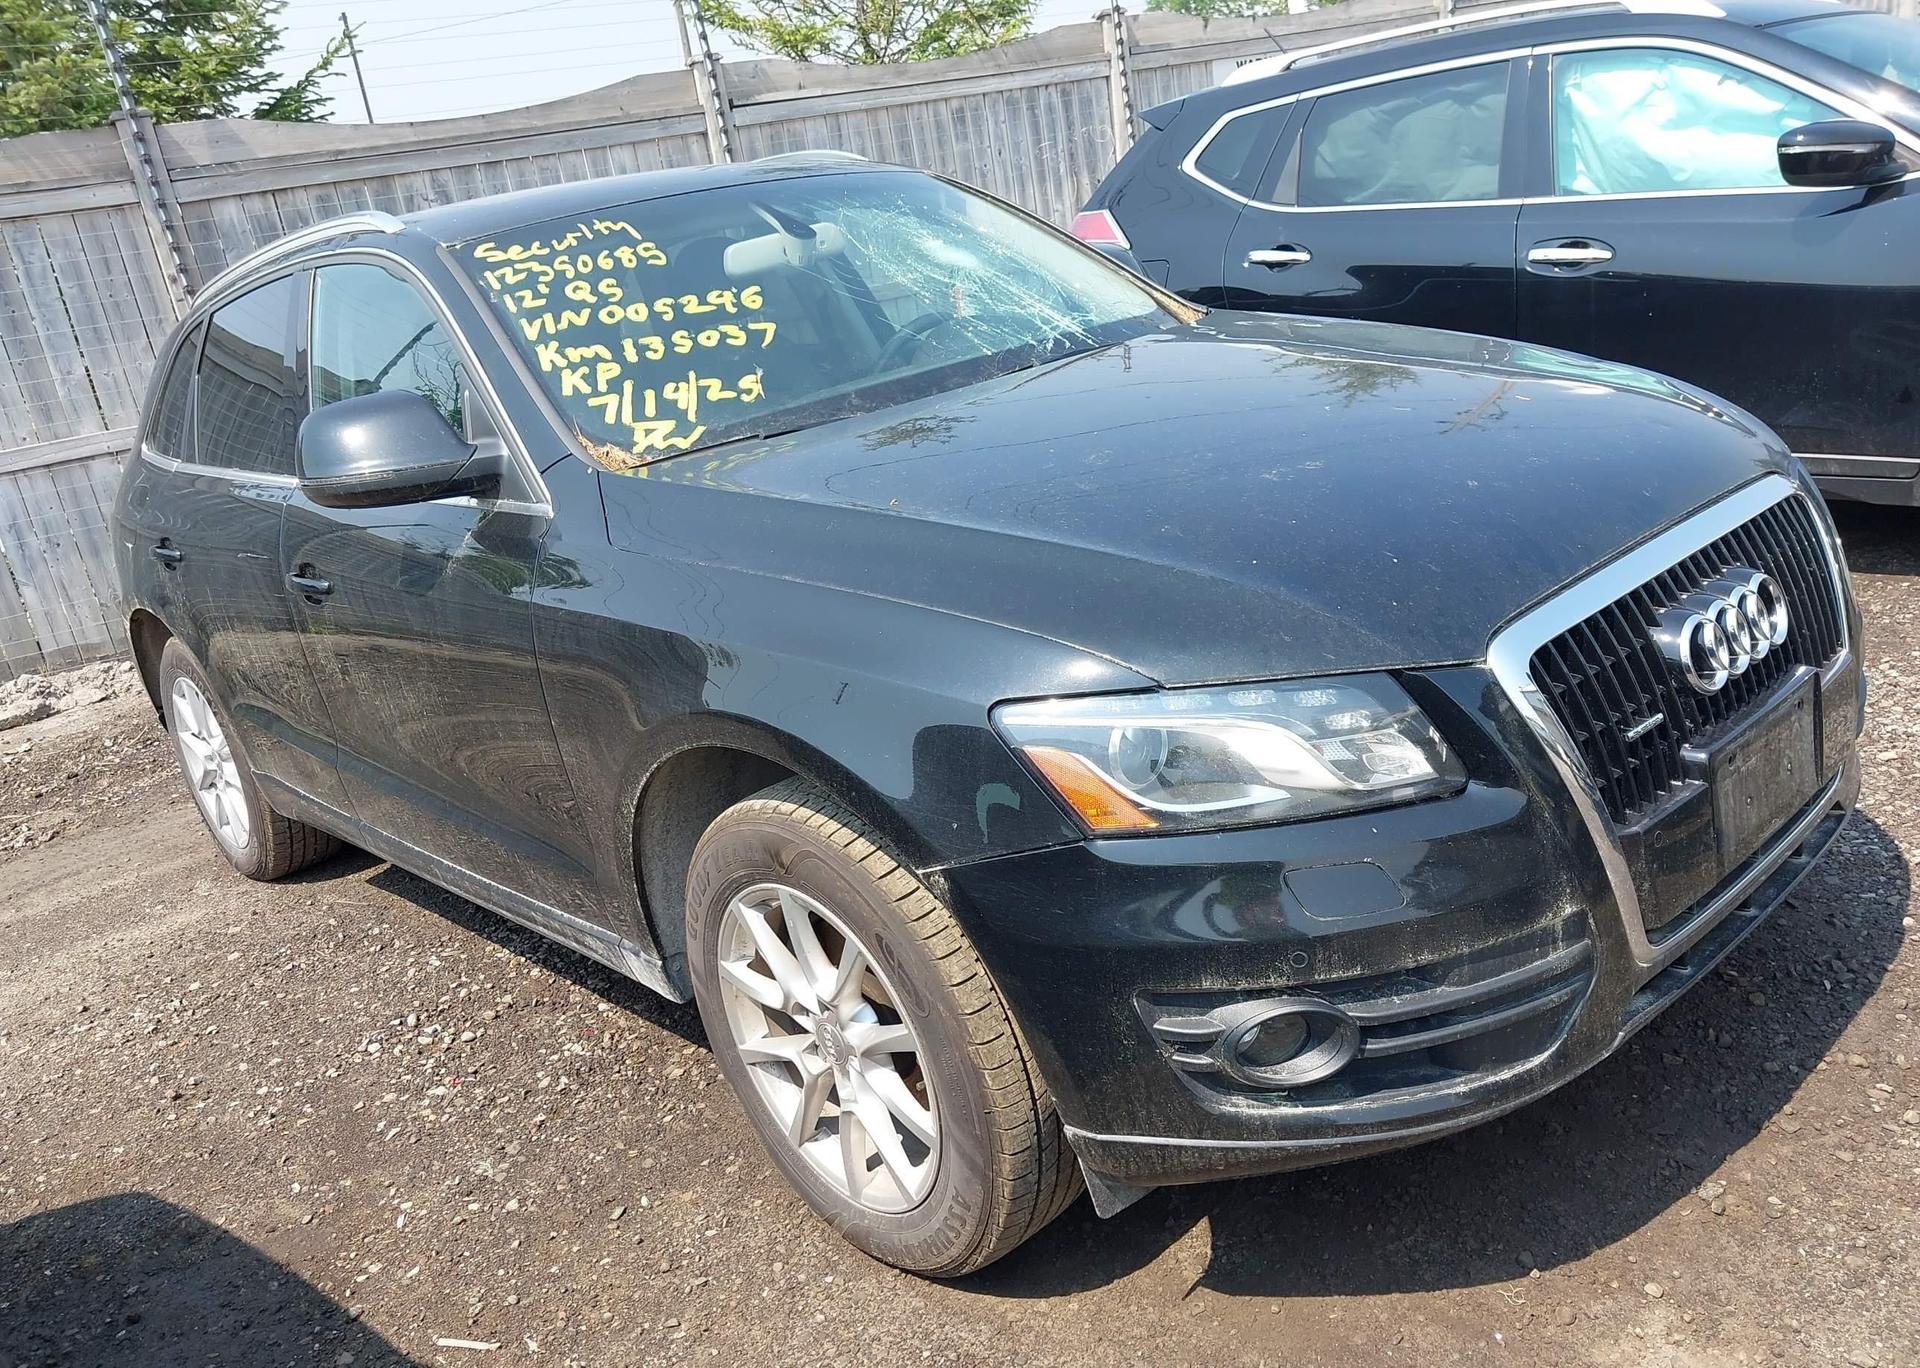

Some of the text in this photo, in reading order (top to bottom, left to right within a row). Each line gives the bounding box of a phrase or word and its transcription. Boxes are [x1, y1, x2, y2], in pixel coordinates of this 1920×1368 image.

[519, 307, 592, 341] VIN
[622, 322, 777, 363] 135037
[560, 361, 623, 397] KP
